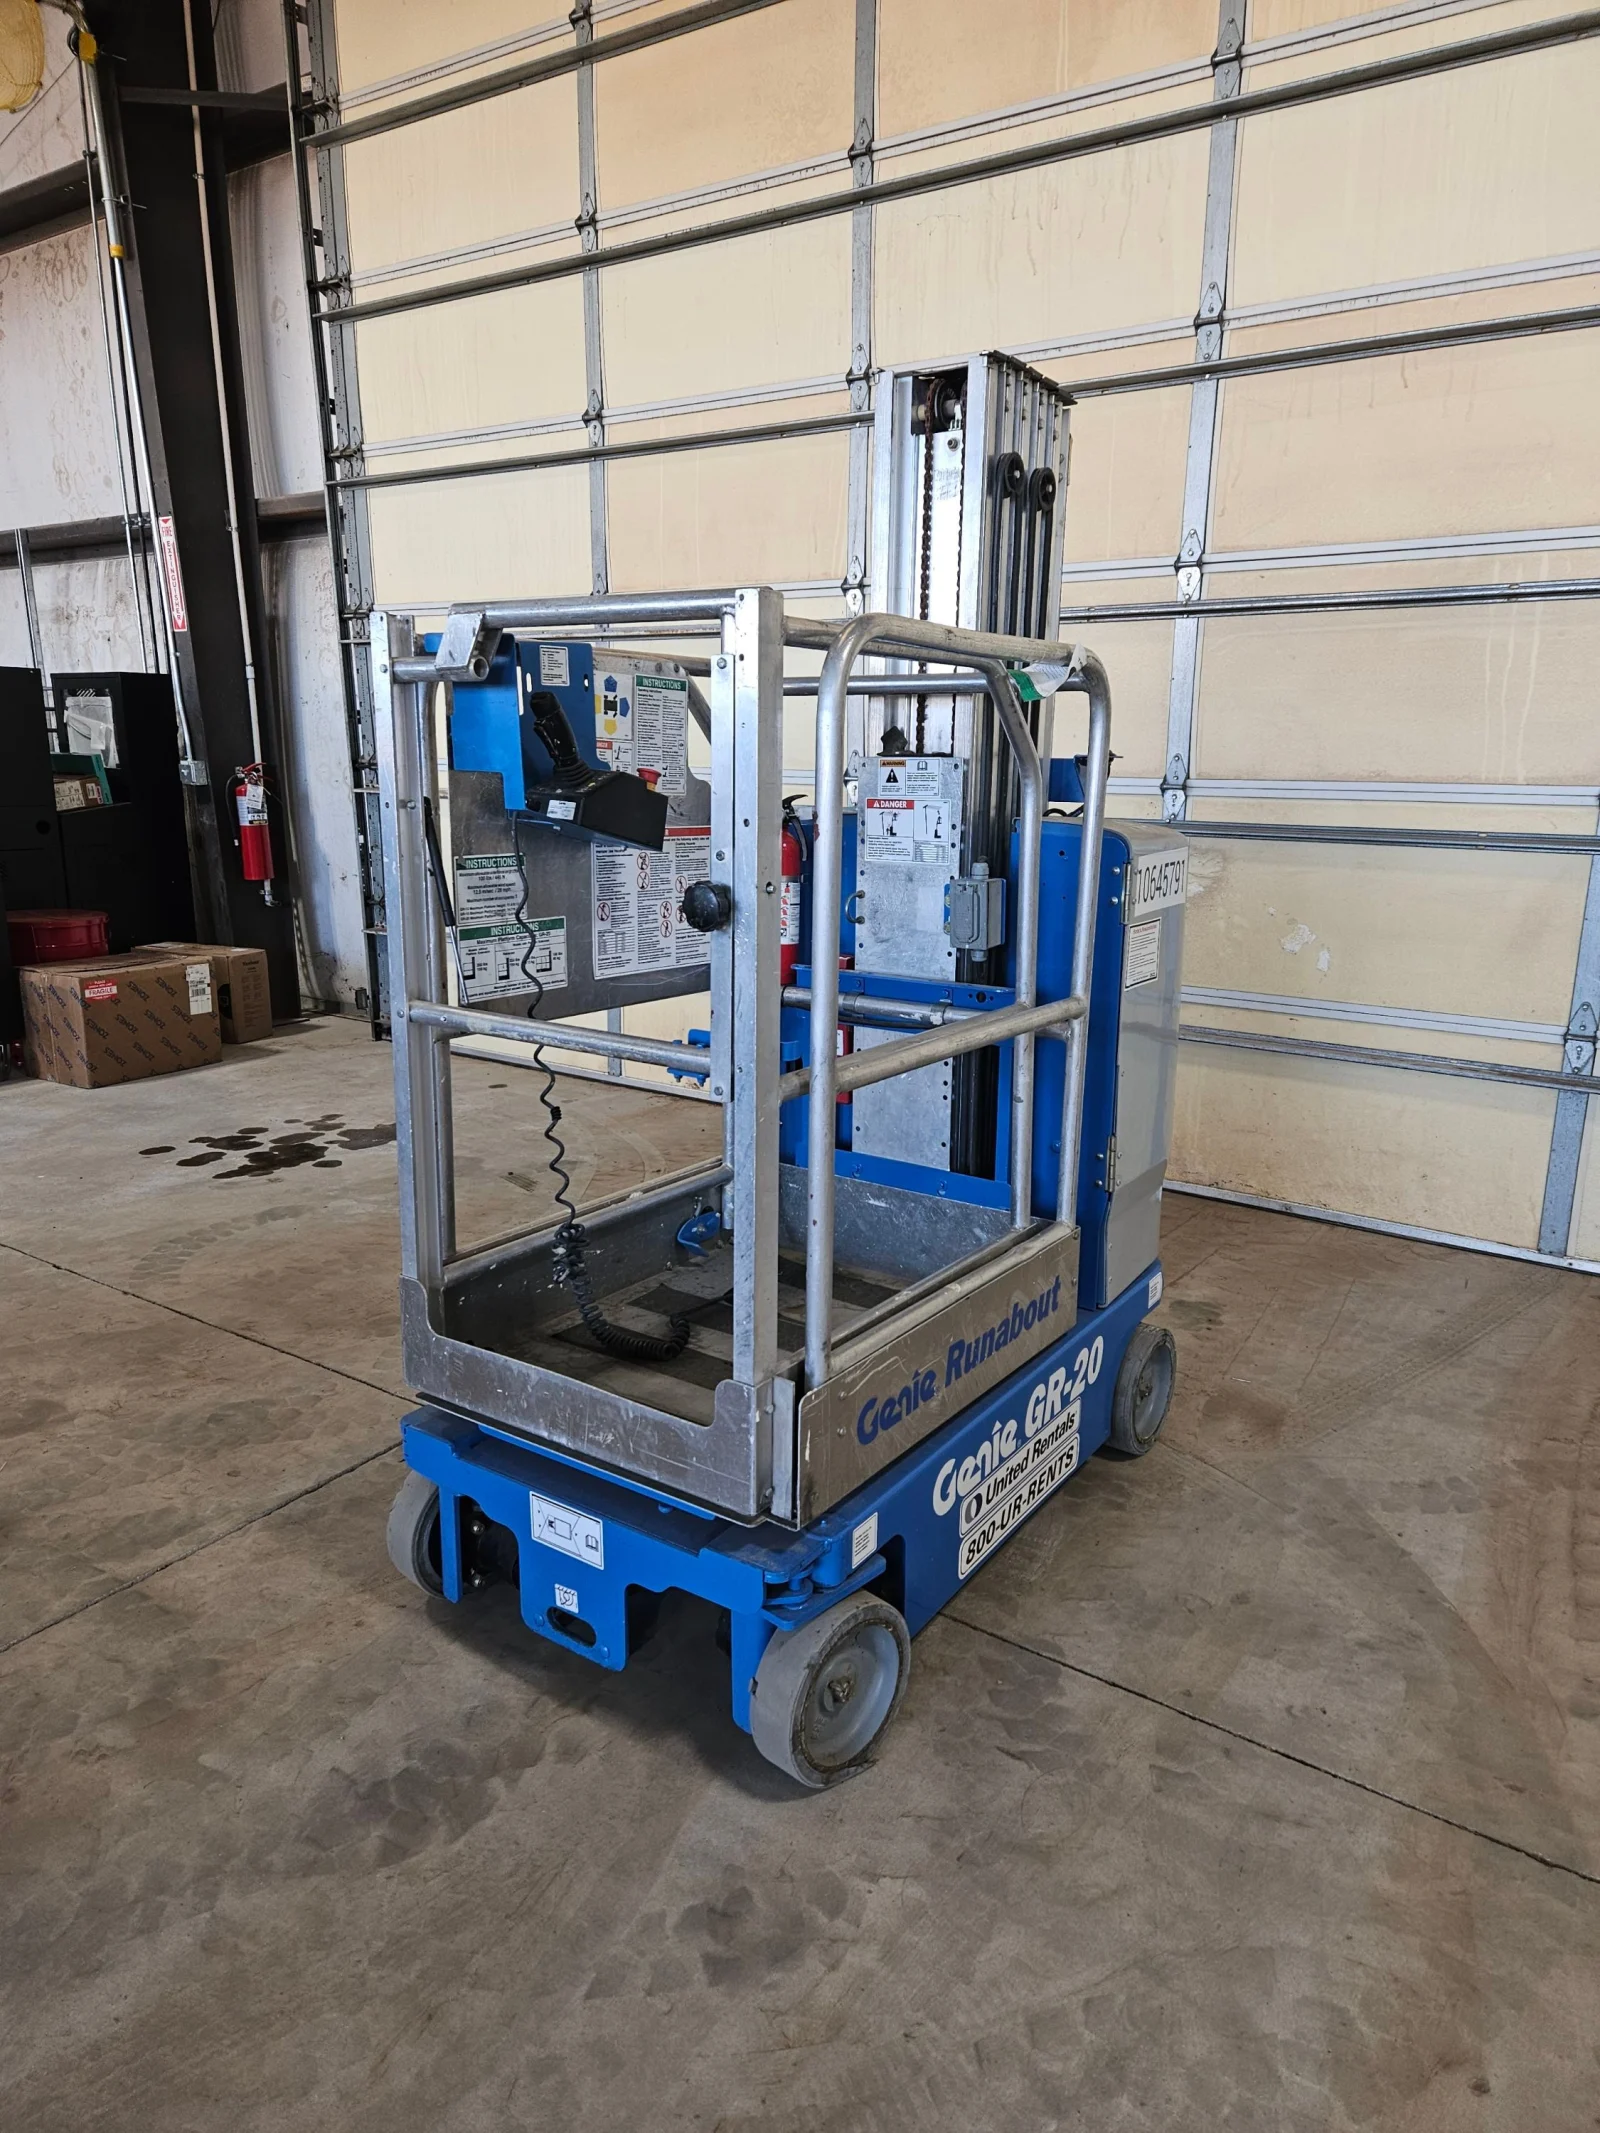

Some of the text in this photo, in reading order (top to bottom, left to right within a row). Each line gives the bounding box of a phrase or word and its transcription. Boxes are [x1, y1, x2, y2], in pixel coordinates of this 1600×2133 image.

[161, 525, 173, 537] FIRE
[166, 540, 181, 620] EXTINGUISHER
[642, 679, 682, 690] INSTRUCTIONS
[465, 857, 517, 869] INSTRUCTIONS
[1137, 859, 1186, 905] 10645791
[490, 921, 540, 936] INSTRUCTNS
[89, 987, 114, 996] FRAGILE
[857, 1275, 1061, 1446] Genie Runabout
[932, 1335, 1104, 1517] Genie GR-20
[985, 1412, 1076, 1504] United Rentals
[965, 1445, 1074, 1566] 800-UR-RENTS
